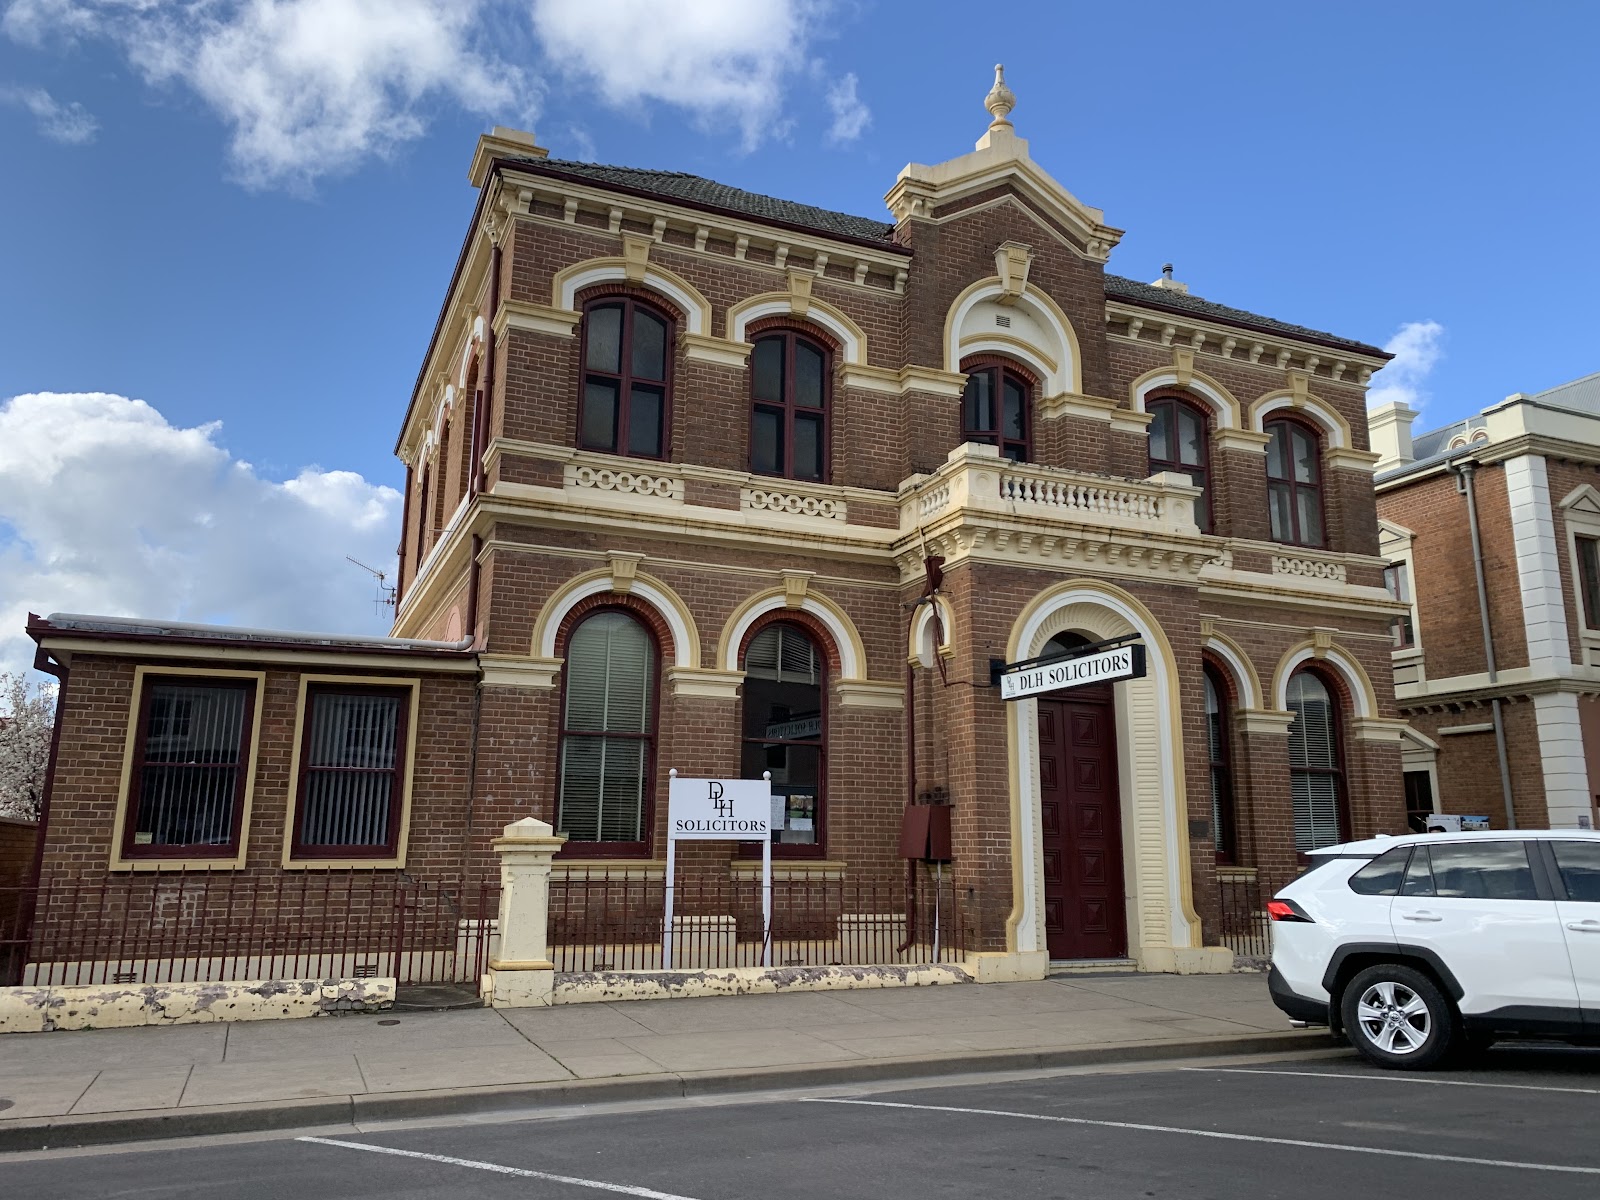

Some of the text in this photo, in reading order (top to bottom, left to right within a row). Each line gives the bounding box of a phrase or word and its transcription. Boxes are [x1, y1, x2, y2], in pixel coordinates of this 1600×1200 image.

[1020, 653, 1129, 690] DLH SOLICITORS
[708, 781, 734, 817] DLH
[676, 819, 766, 831] SOLICITORS
